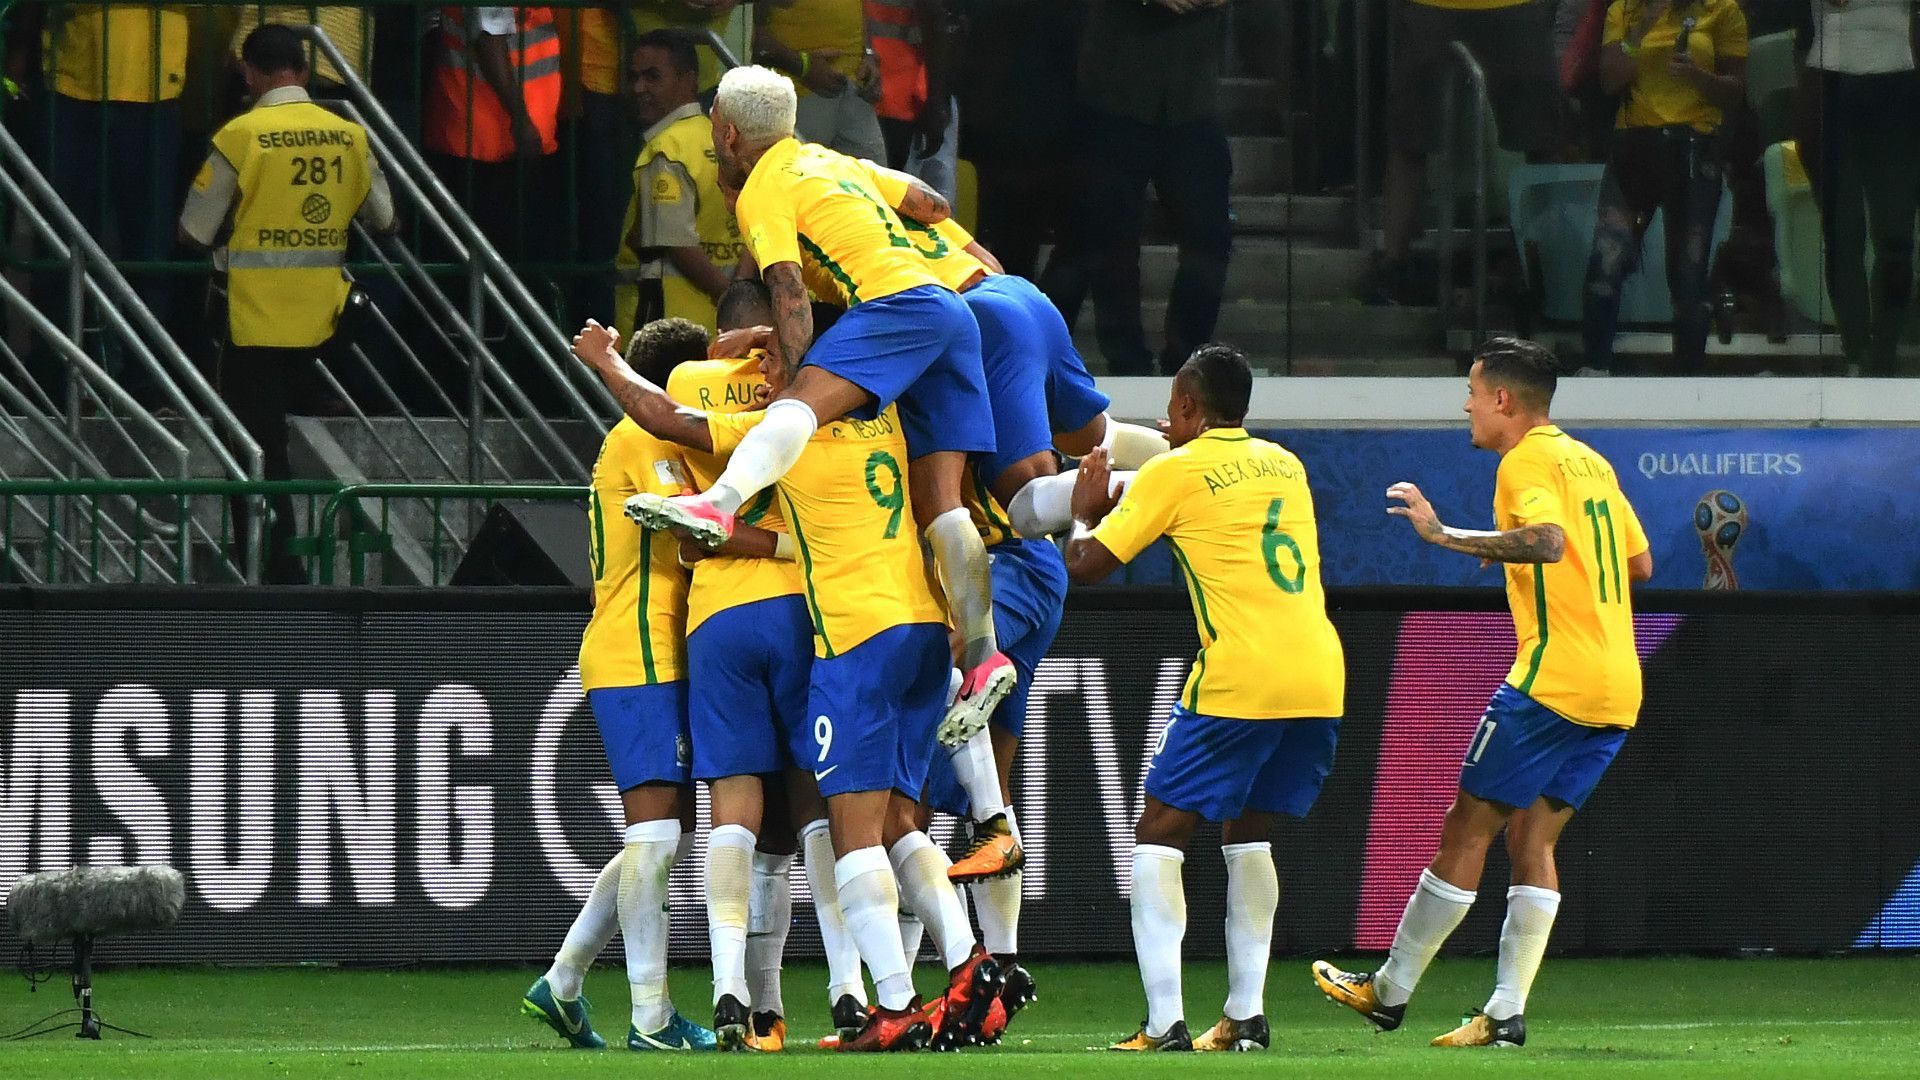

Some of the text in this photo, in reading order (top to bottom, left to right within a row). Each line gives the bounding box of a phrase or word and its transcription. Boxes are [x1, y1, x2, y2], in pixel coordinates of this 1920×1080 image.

[290, 155, 343, 186] 281
[699, 386, 719, 410] R.
[1203, 459, 1250, 497] ALEX
[1637, 451, 1803, 480] QUALIFIERS
[864, 450, 905, 539] 9
[1261, 497, 1306, 595] 6
[1583, 497, 1622, 605] 11
[814, 715, 833, 762] 9
